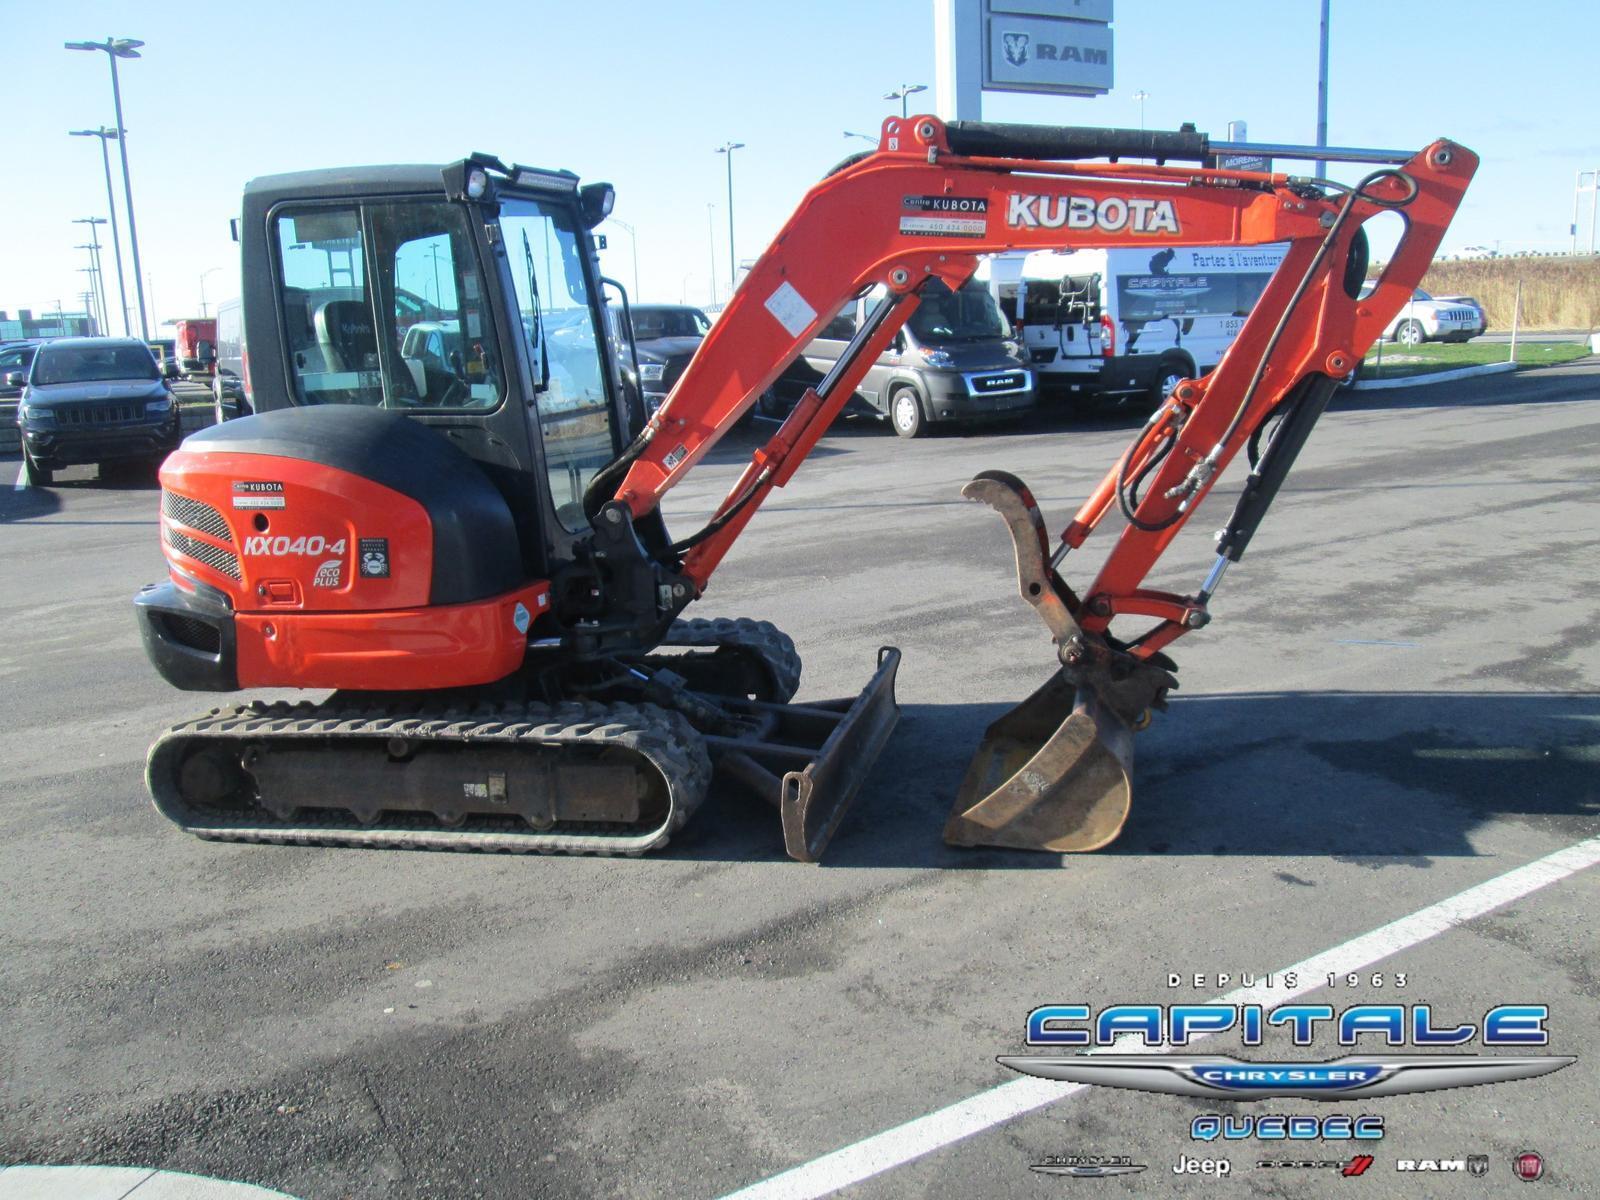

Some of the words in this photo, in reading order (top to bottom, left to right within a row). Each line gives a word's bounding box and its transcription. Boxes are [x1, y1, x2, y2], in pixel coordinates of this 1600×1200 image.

[1036, 43, 1107, 65] RAM
[933, 199, 986, 212] KUBOTA
[1007, 193, 1179, 233] KUBOTA
[1192, 252, 1226, 267] Partez
[1127, 277, 1208, 288] CAPITALE
[986, 378, 1014, 387] RAM
[250, 483, 283, 491] KUBOTA
[243, 535, 346, 557] KX040-4
[320, 567, 341, 577] eco
[313, 577, 340, 587] PLUS
